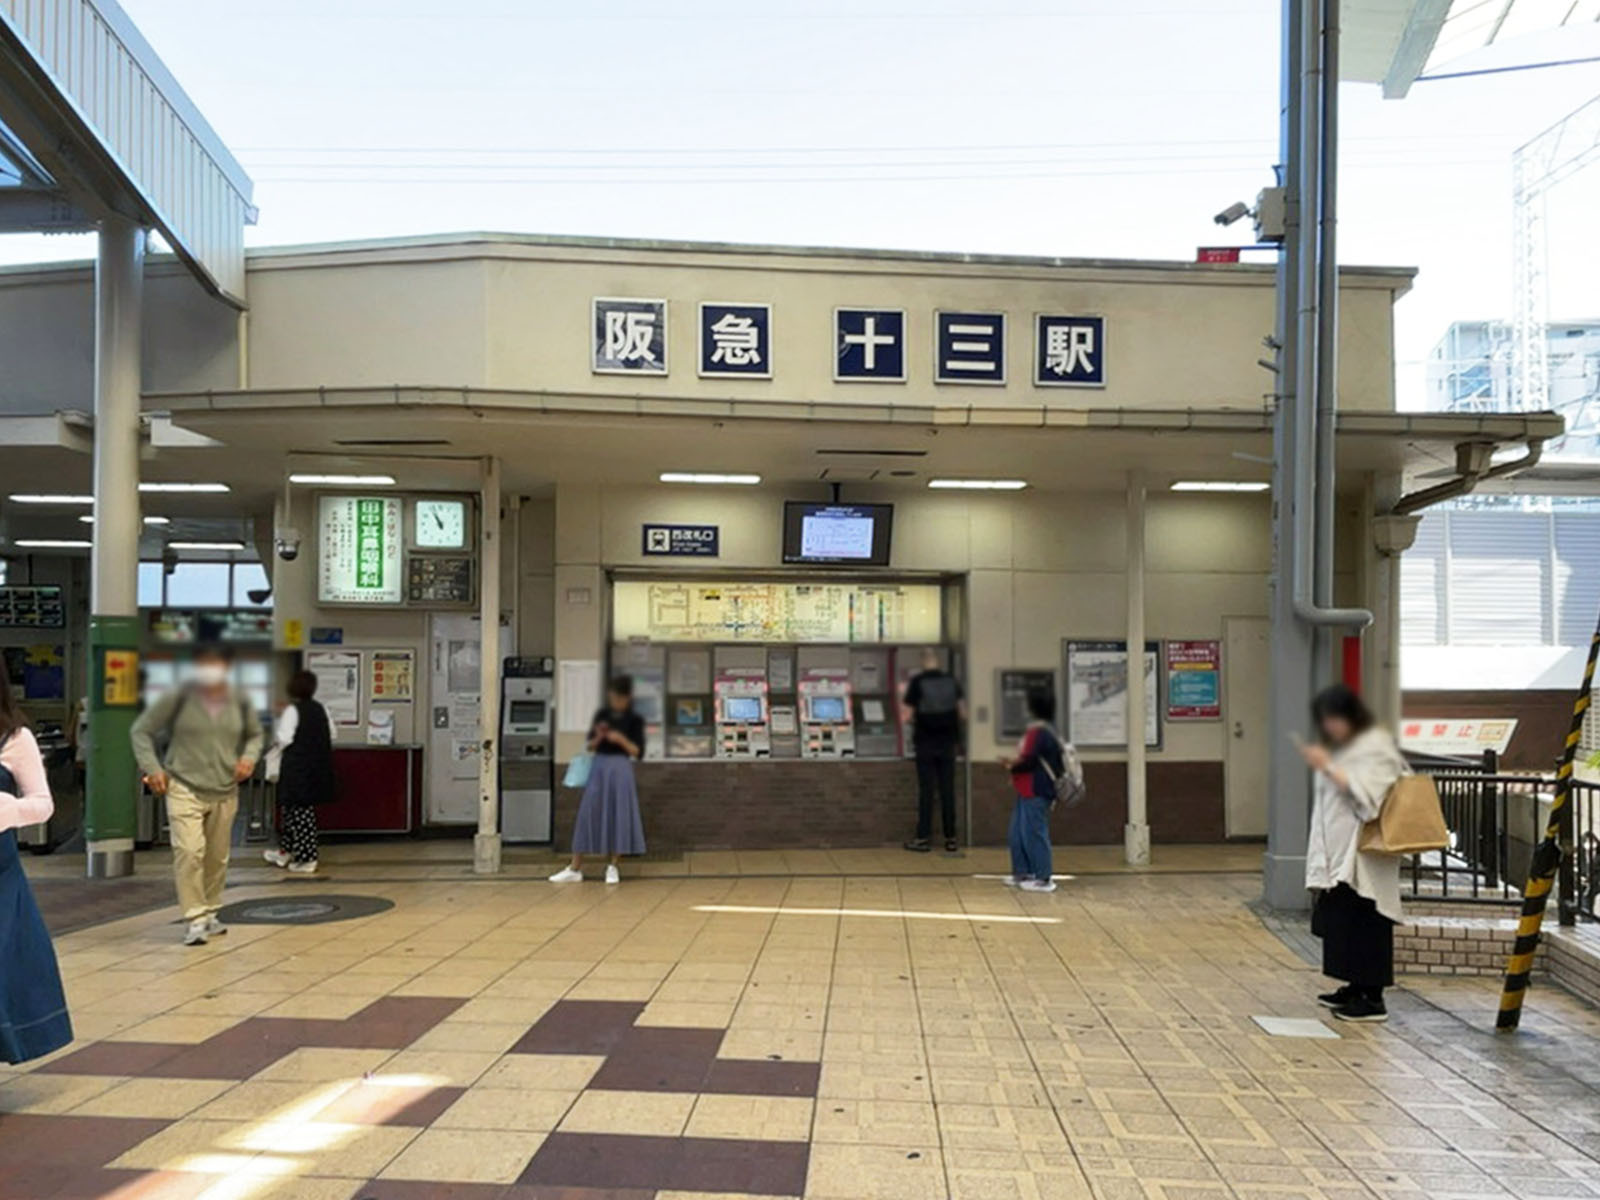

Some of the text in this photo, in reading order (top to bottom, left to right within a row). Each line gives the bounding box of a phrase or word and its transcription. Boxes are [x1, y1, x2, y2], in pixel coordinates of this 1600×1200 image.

[604, 311, 1095, 376] 阪急 十三駅
